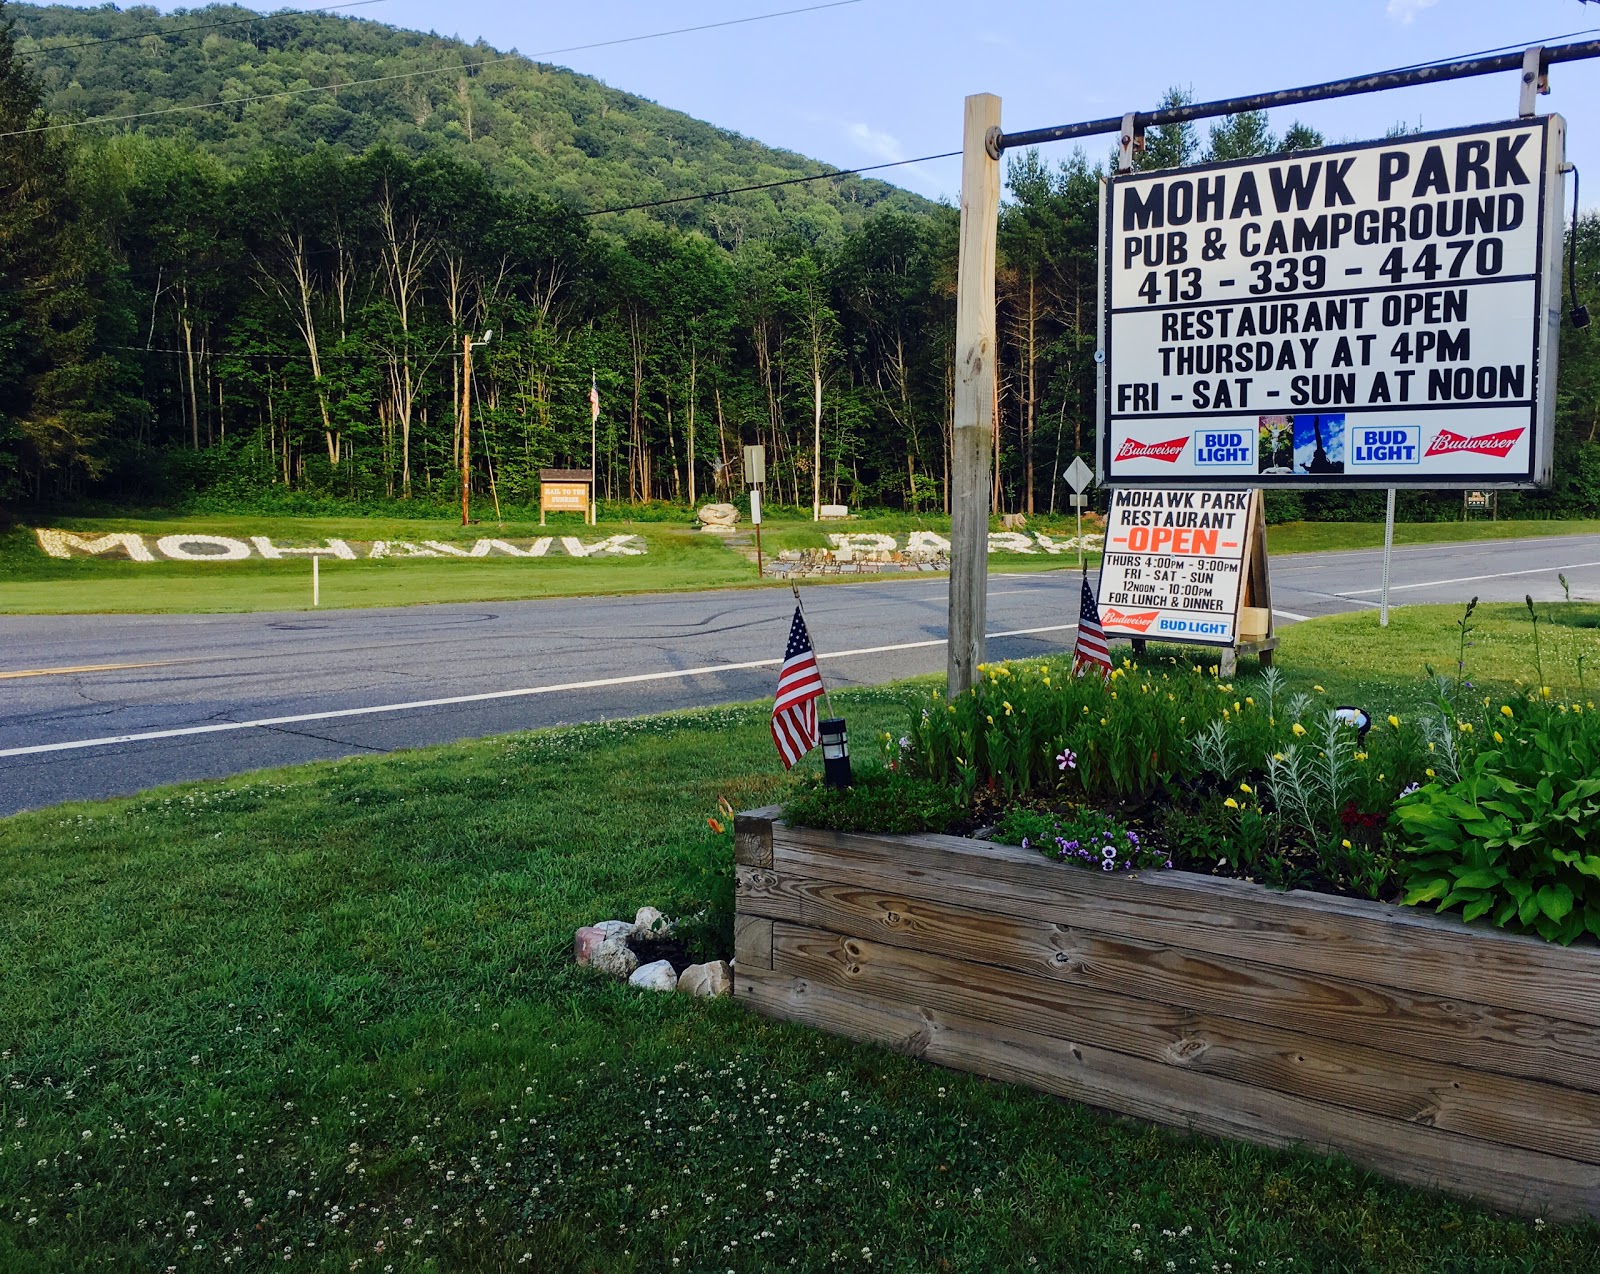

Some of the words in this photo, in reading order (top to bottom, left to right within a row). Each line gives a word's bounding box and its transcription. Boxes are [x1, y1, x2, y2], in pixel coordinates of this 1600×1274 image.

[1123, 156, 1357, 232] MOHAWK
[1378, 133, 1532, 202] PARK
[1124, 231, 1188, 269] PUB
[1201, 227, 1227, 262] &
[1239, 192, 1524, 258] CAMPGROUND
[1138, 267, 1202, 304] 413
[1249, 255, 1326, 295] 339
[1379, 237, 1503, 284] 4470
[1162, 297, 1369, 342] RESTAURANT
[1382, 289, 1468, 327] OPEN
[1158, 338, 1320, 376] THURSDAY
[1331, 334, 1377, 368] AT
[1390, 328, 1470, 364] 4PM
[1117, 382, 1159, 412] FRI
[1192, 378, 1253, 409] SAT
[1290, 373, 1356, 406] SUN
[1368, 369, 1416, 403] AT
[1428, 364, 1525, 401] NOON
[1205, 434, 1242, 448] BUD
[1364, 430, 1407, 446] BUD
[1430, 434, 1516, 452] Budweiser
[1119, 440, 1184, 456] Budweiser
[1198, 448, 1249, 462] LIGHT
[1356, 445, 1415, 461] LIGHT
[1115, 491, 1195, 508] MOHAWK
[1200, 492, 1247, 510] PARK
[1120, 509, 1236, 530] RESTAURANT
[36, 527, 648, 562] MOHAWK
[1106, 554, 1141, 568] THURS
[1144, 557, 1184, 570] 4:00PM
[1197, 559, 1238, 573] 9:00PM
[1124, 568, 1141, 580] FRI
[1153, 570, 1177, 582] SAT
[1189, 572, 1214, 584] SUN
[1122, 581, 1156, 594] 12NOON
[1168, 583, 1213, 597] 10:00PM
[1108, 592, 1128, 604] FOR
[1131, 593, 1167, 607] LUNCH
[1170, 596, 1179, 607] &
[1182, 597, 1223, 611] DINNER
[1102, 611, 1152, 626] Budweiser
[1160, 619, 1189, 631] BUD
[1189, 621, 1227, 634] LIGHT
